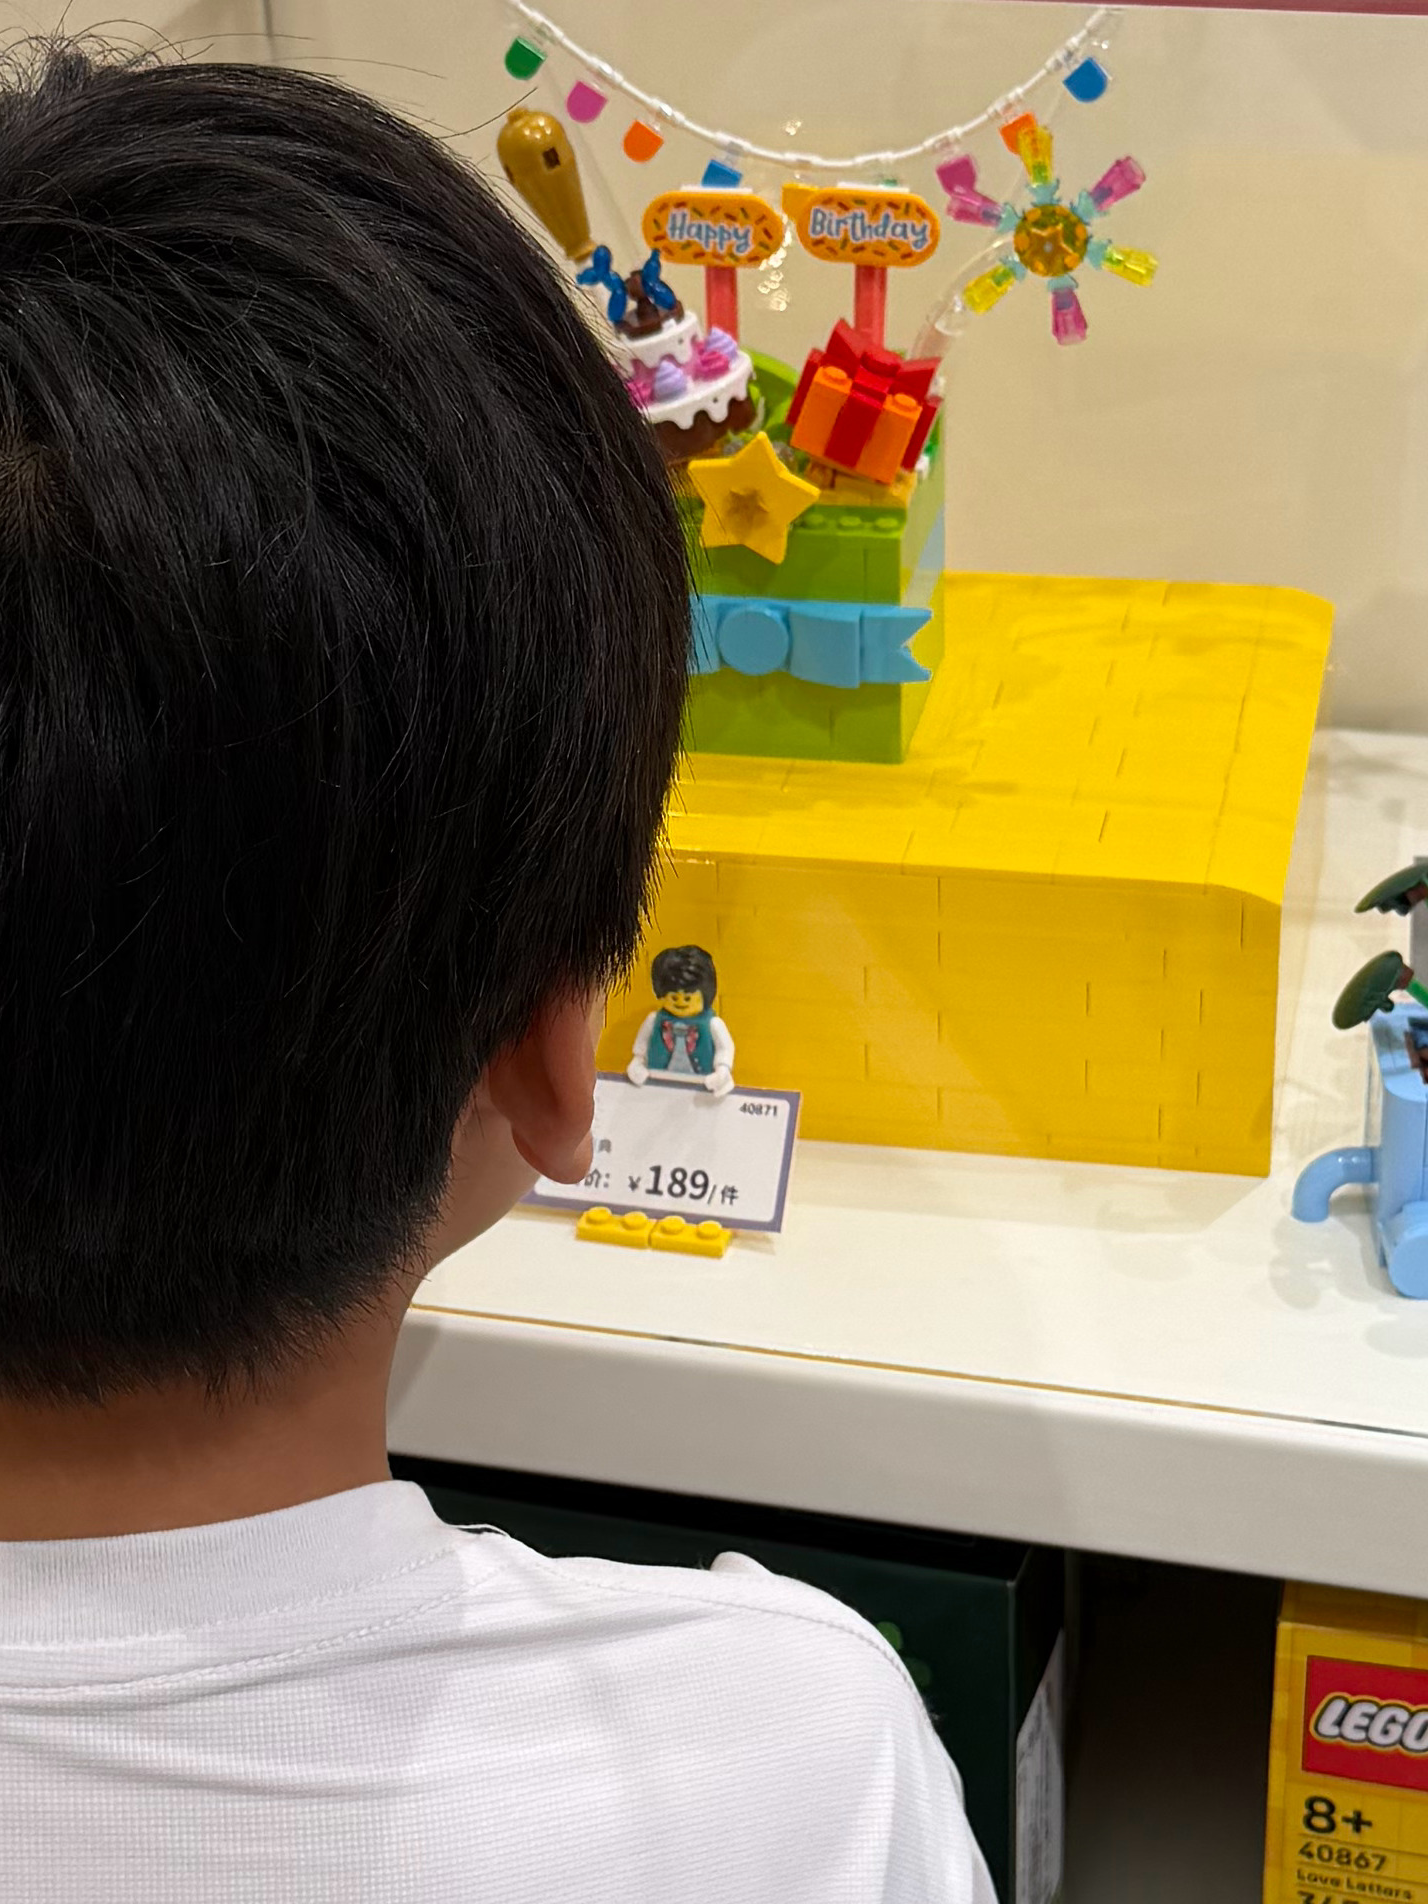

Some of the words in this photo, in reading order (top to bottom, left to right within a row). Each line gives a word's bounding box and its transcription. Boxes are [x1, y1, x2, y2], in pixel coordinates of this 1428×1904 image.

[667, 210, 752, 253] Happy
[809, 209, 929, 253] Birthday
[739, 1102, 779, 1117] 40871
[1303, 1796, 1372, 1834] 8+
[1299, 1842, 1386, 1872] 40867
[1297, 1869, 1341, 1887] Love
[1346, 1878, 1412, 1900] Letters
